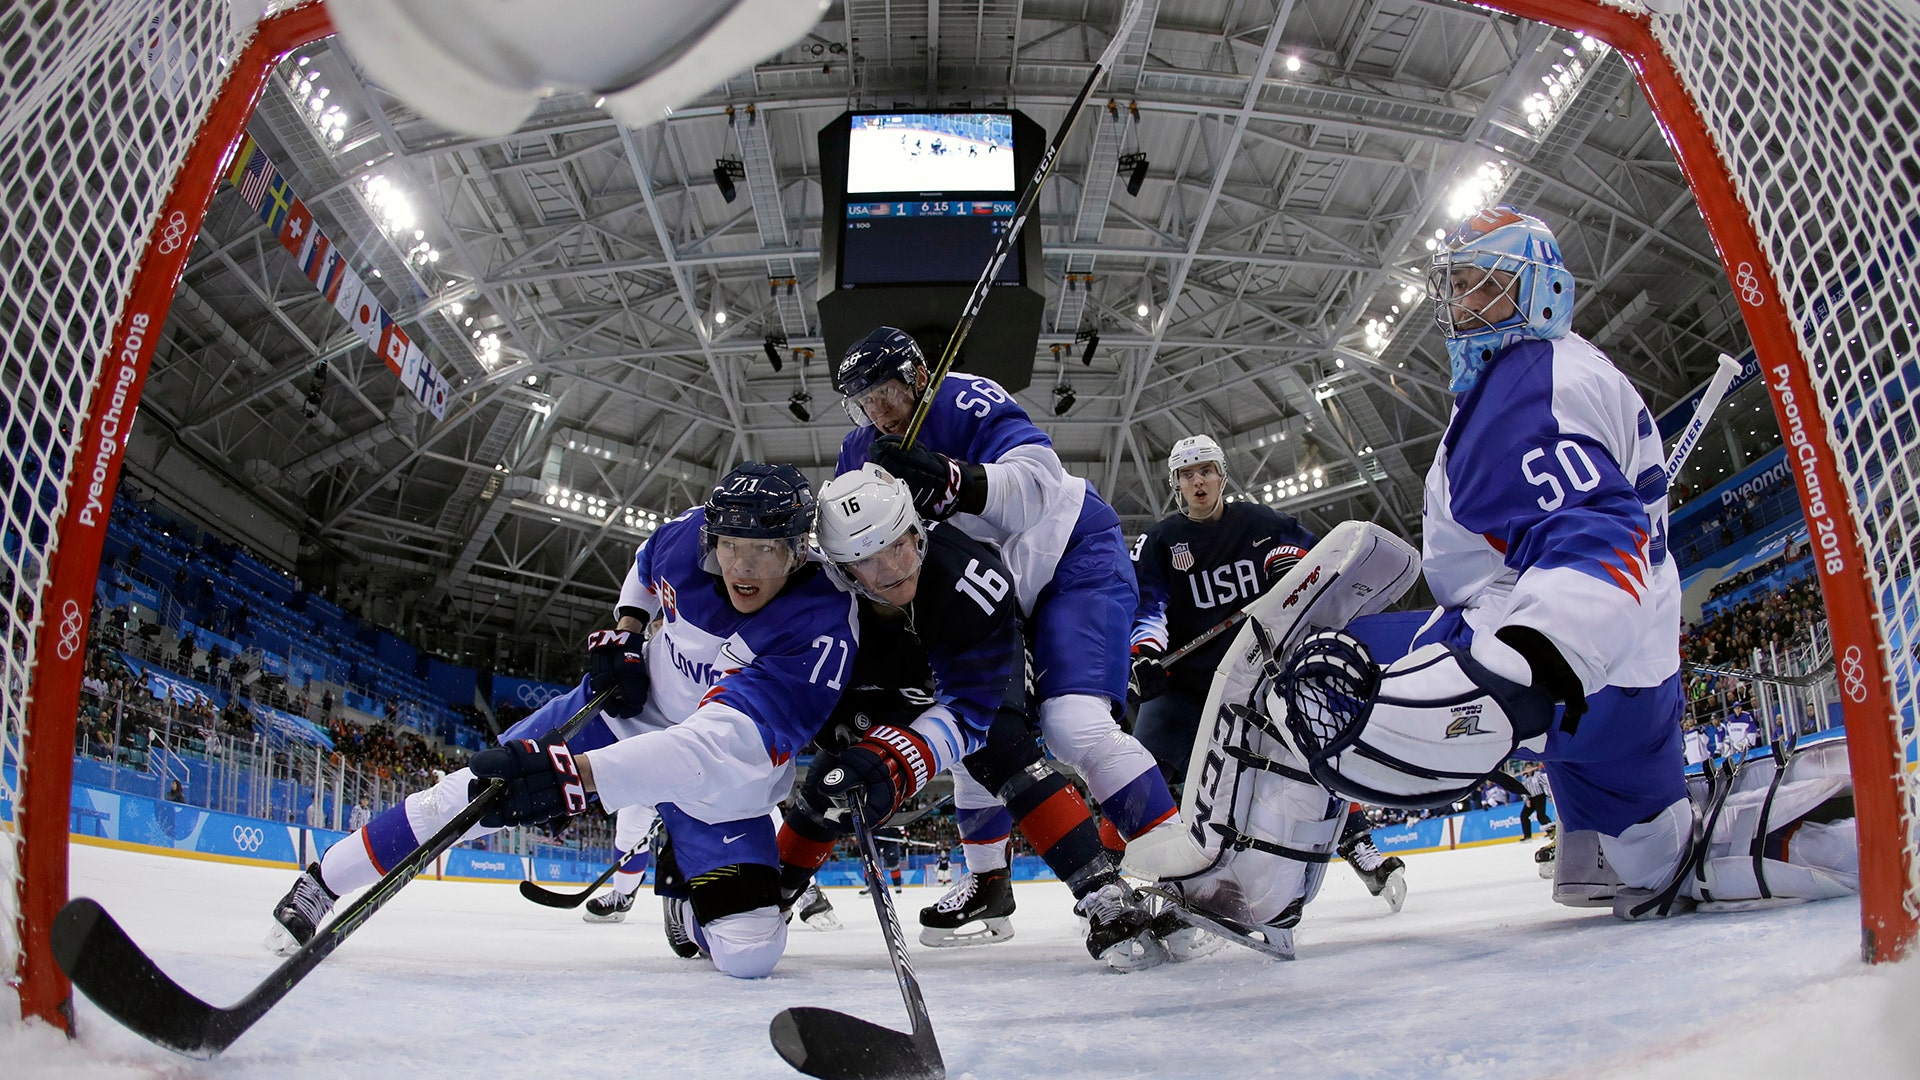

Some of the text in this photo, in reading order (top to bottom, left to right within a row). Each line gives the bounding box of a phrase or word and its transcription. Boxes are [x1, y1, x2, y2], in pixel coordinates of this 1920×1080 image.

[1034, 146, 1056, 184] CCM
[849, 206, 869, 215] USA
[896, 203, 906, 215] 1
[957, 203, 966, 215] 1
[79, 313, 149, 527] PyeongChang 2018
[956, 380, 1007, 418] 56
[1666, 418, 1703, 483] RONTIER
[1773, 364, 1827, 518] PyeongChang
[1817, 517, 1844, 576] 2018
[731, 477, 760, 493] 71
[1520, 440, 1601, 512] 50
[841, 497, 861, 517] 16
[1174, 544, 1188, 553] USA
[955, 558, 1010, 616] 16
[1189, 559, 1260, 609] USA
[1352, 582, 1374, 593] CCM
[808, 634, 850, 691] 71
[869, 725, 929, 798] WARRIO
[1190, 703, 1236, 849] CCM
